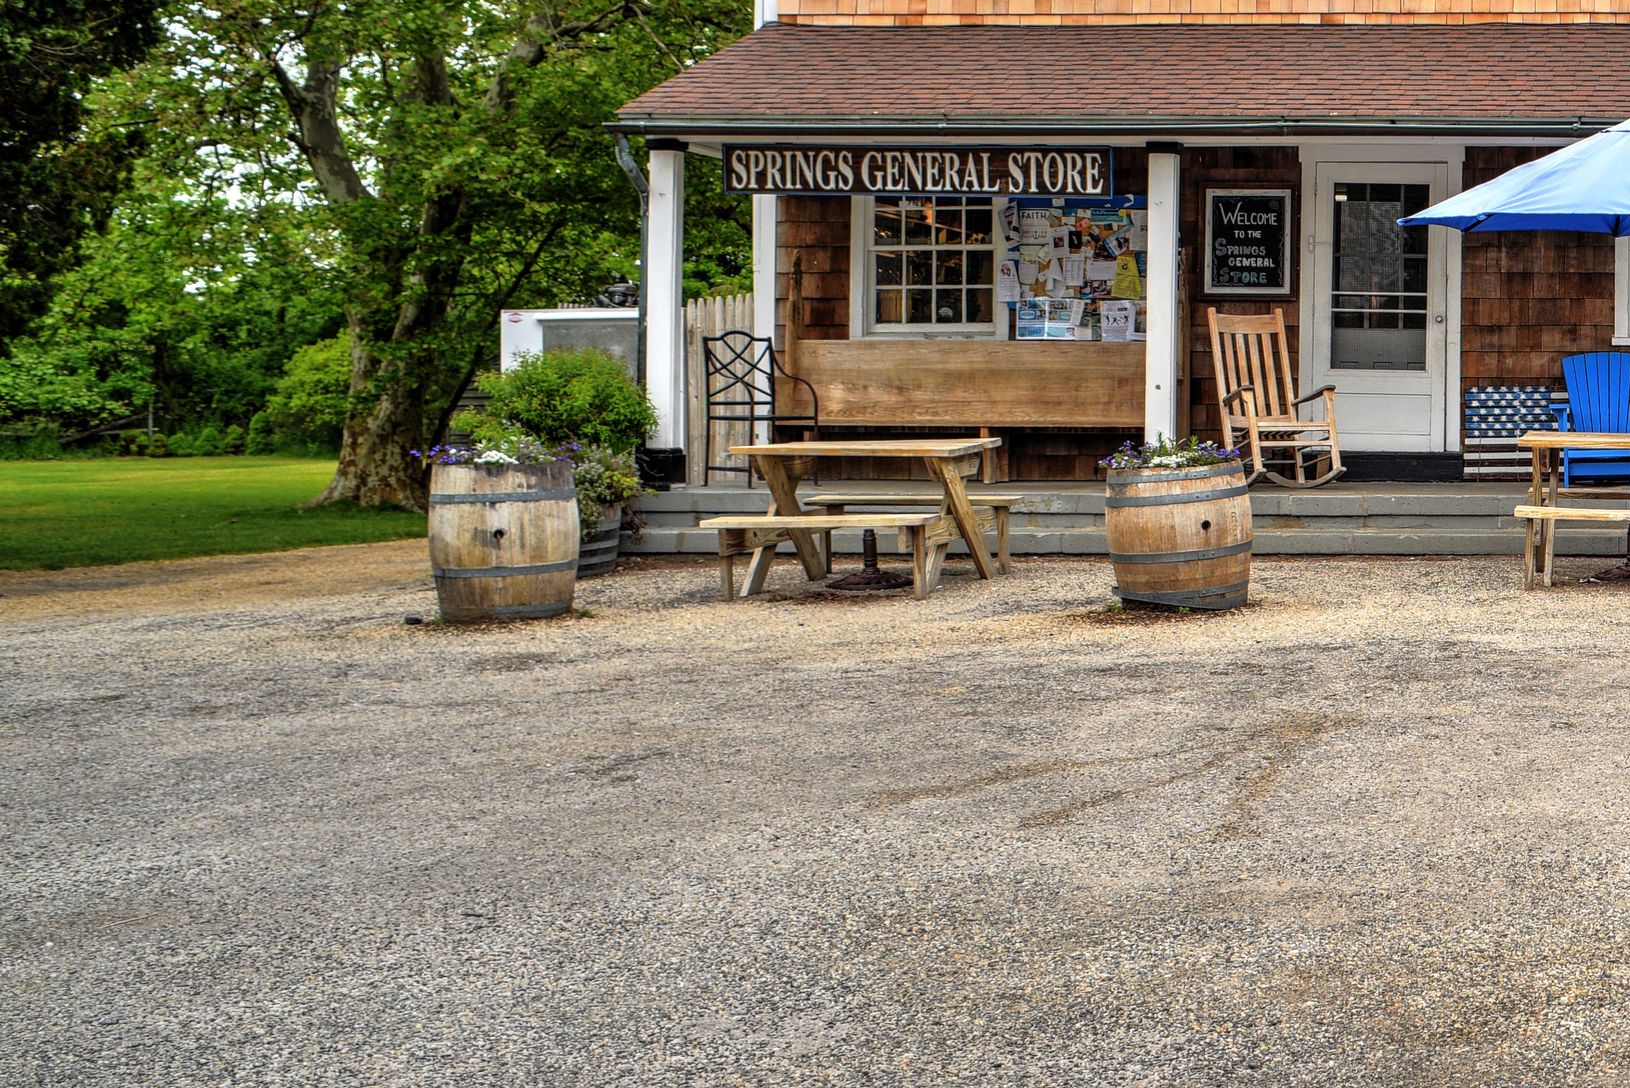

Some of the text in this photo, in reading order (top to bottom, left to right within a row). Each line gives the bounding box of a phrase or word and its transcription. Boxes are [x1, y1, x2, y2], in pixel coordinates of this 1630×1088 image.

[731, 150, 1104, 194] SPRINGS GENERAL STORE
[1021, 211, 1047, 220] FAITH
[1218, 201, 1278, 225] WELCOME
[1234, 230, 1262, 239] TO THE
[1215, 237, 1266, 256] SPRINGS
[1228, 257, 1276, 268] GENERAL
[1219, 267, 1268, 283] STORE
